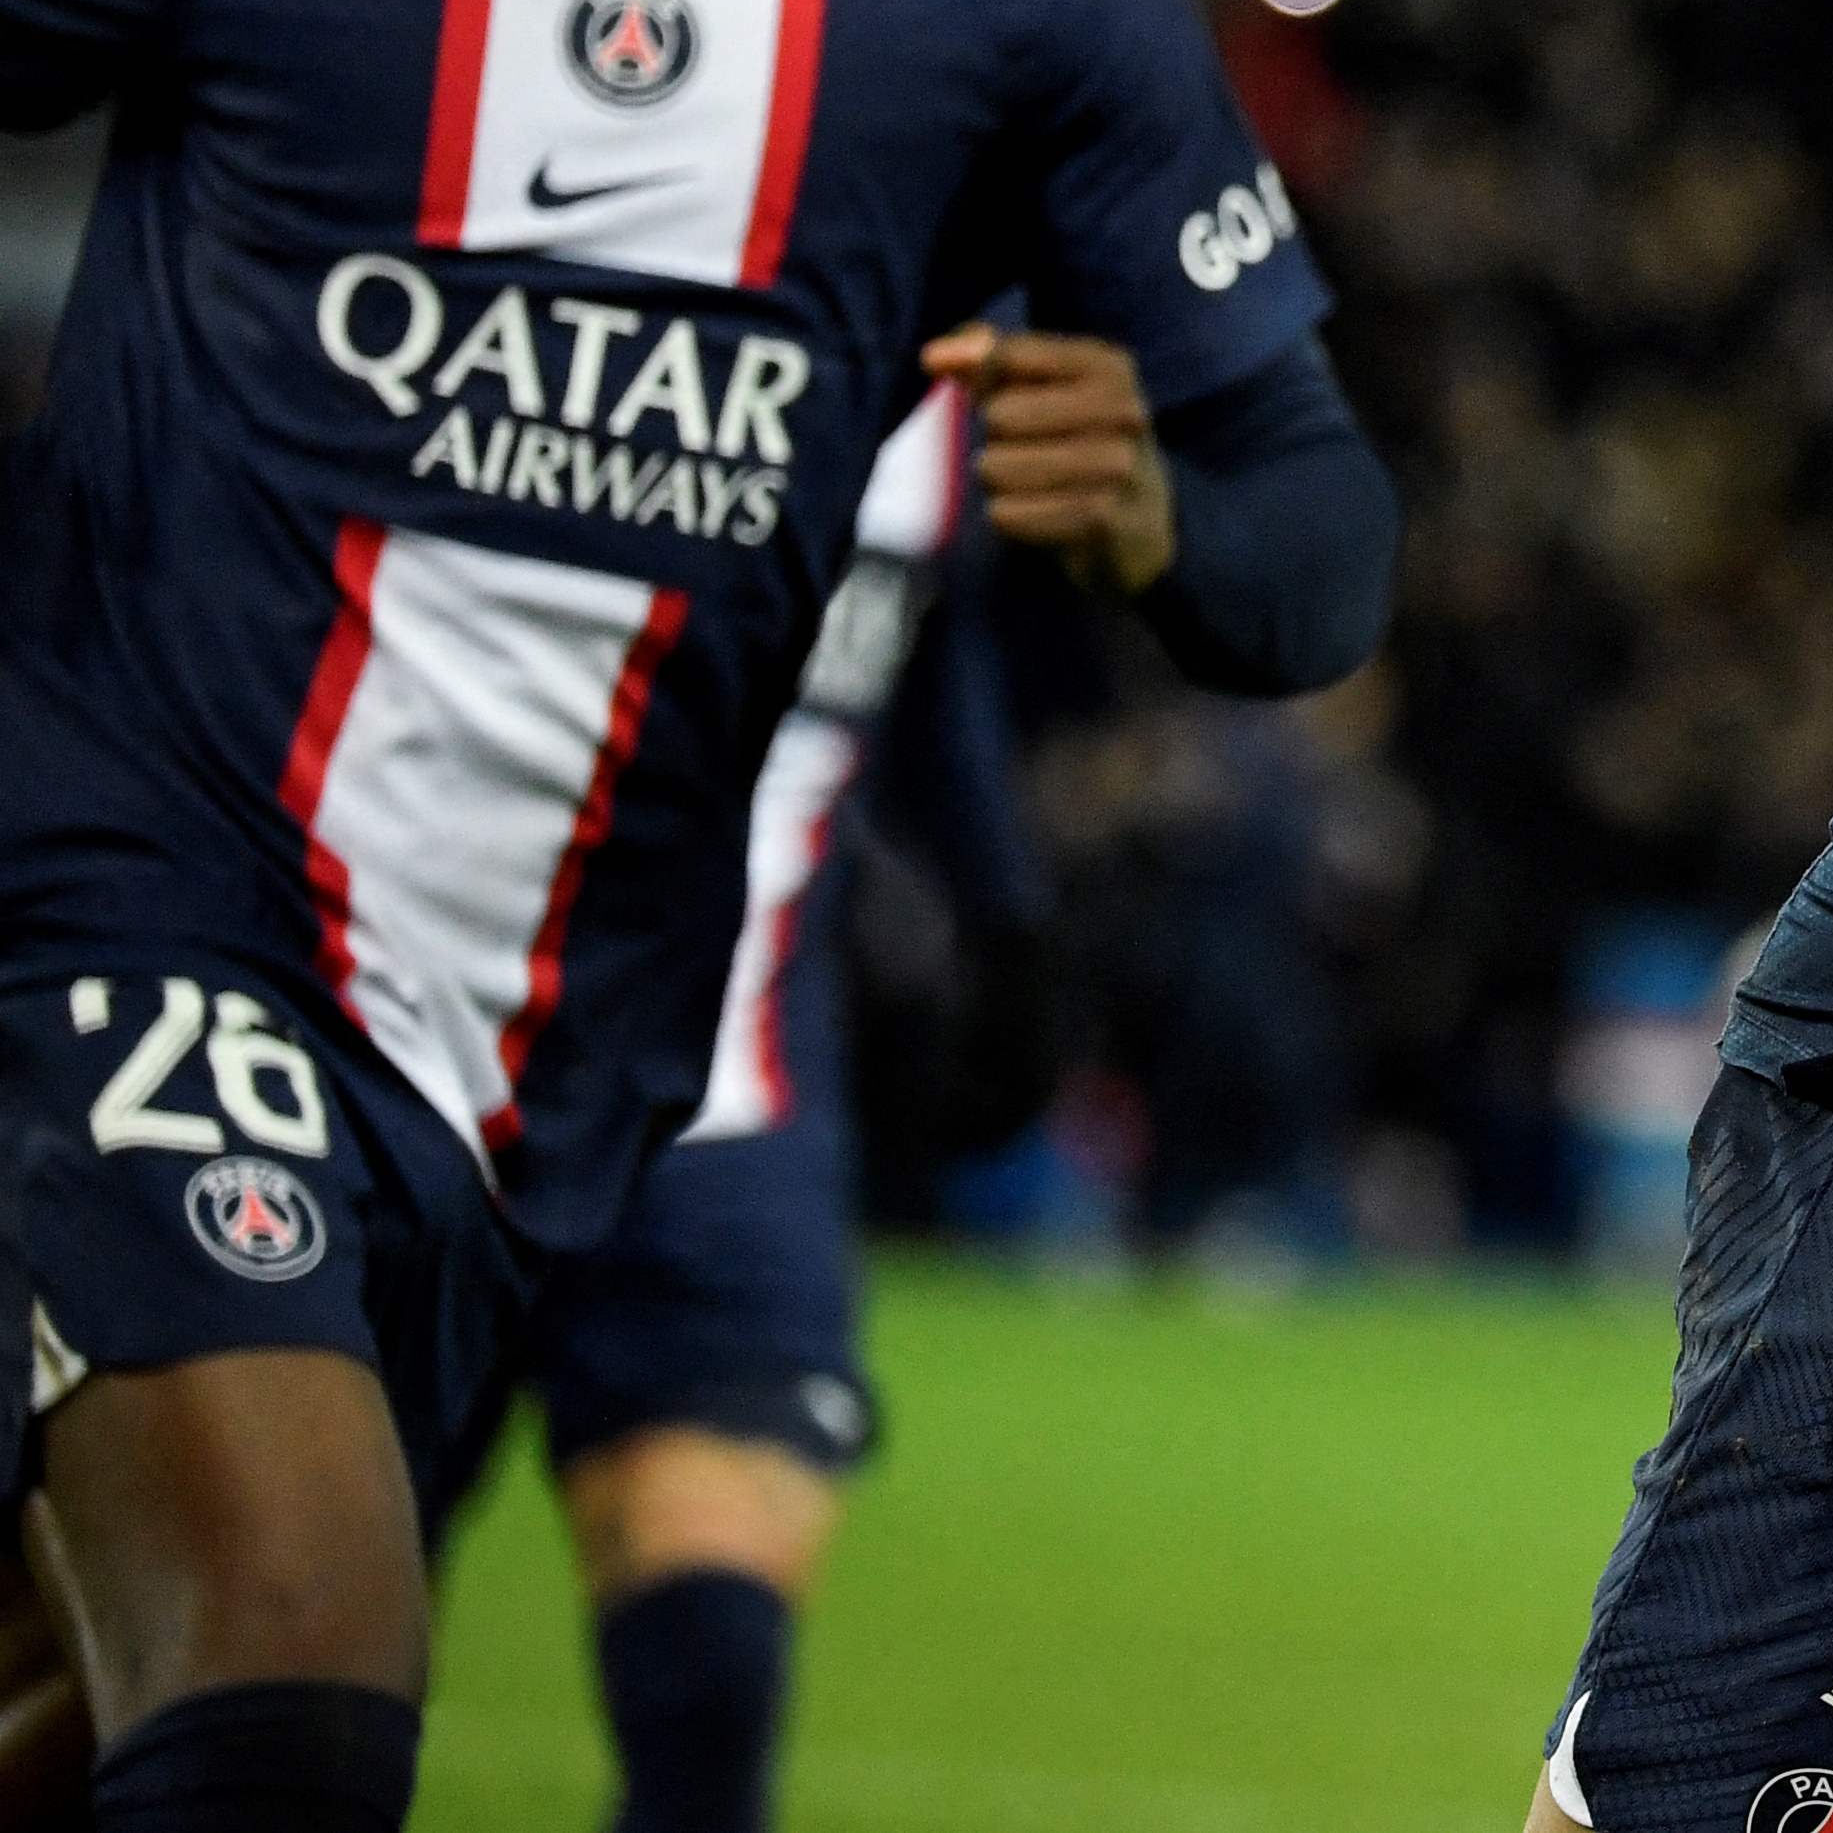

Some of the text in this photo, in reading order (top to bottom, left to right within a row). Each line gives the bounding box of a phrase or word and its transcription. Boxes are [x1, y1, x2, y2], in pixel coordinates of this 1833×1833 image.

[316, 252, 811, 466] QATAR
[410, 404, 788, 547] AIRWAYS
[69, 975, 330, 1158] 26
